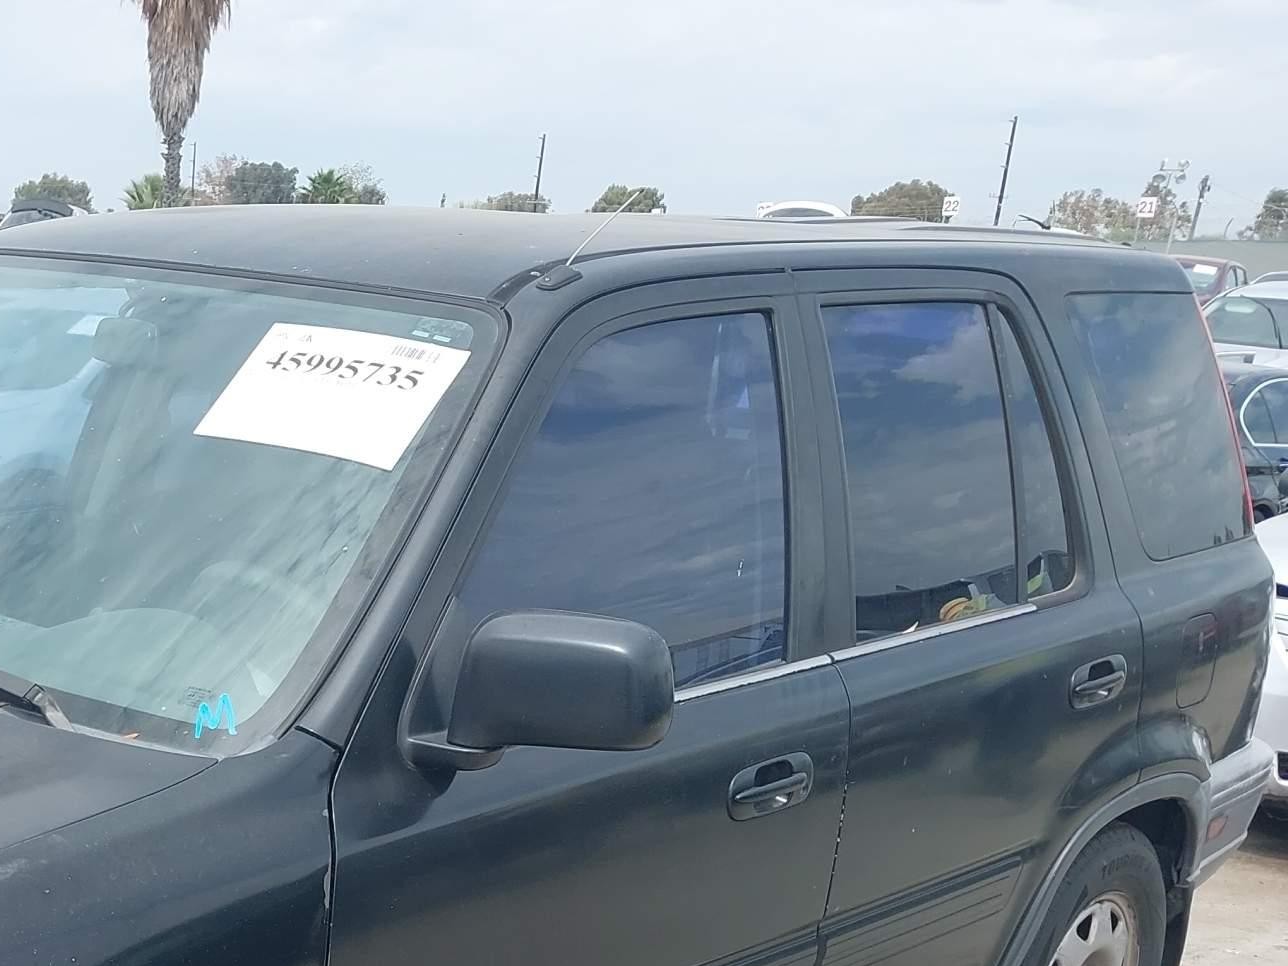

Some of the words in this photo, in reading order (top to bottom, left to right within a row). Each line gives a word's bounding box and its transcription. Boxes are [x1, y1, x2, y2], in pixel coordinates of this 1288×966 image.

[944, 200, 959, 211] 22
[1138, 200, 1154, 213] 21
[265, 350, 425, 391] 45995735
